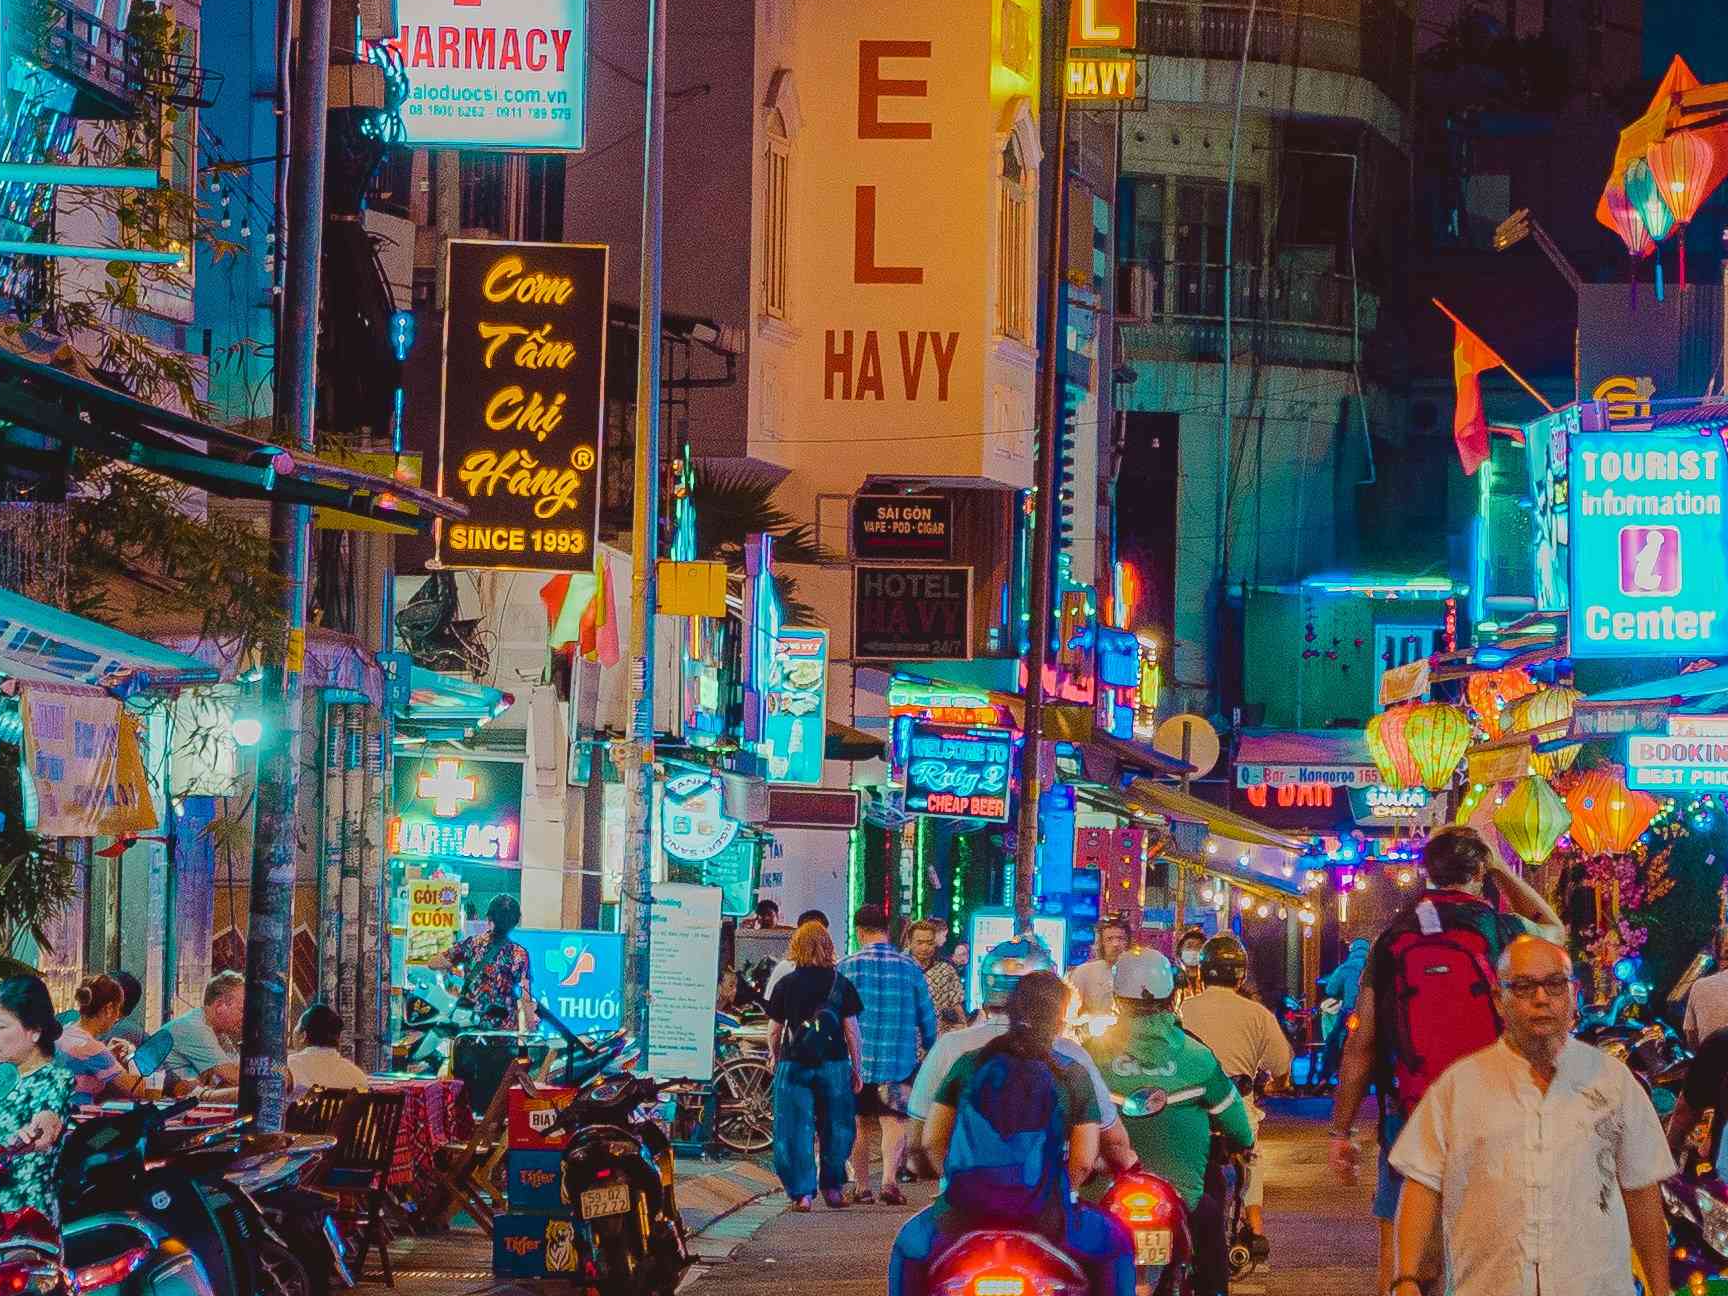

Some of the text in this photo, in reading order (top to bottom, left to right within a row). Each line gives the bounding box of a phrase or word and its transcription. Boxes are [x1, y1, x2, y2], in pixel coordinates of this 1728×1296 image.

[1069, 60, 1133, 97] HAVY
[483, 256, 573, 304] Cơm
[478, 321, 575, 369] Tấm
[485, 385, 567, 442] Chị
[1582, 451, 1720, 481] TOURIST
[1582, 488, 1721, 517] information
[449, 527, 584, 554] SINCE 1993
[863, 520, 887, 534] VAPE
[917, 521, 945, 535] CIGAR
[864, 574, 961, 599] HOTEL
[1585, 605, 1716, 641] Center
[1636, 768, 1684, 785] BEST
[927, 792, 1005, 817] CHEAP BEER
[413, 883, 438, 904] GỎI
[411, 905, 454, 928] CUỐN
